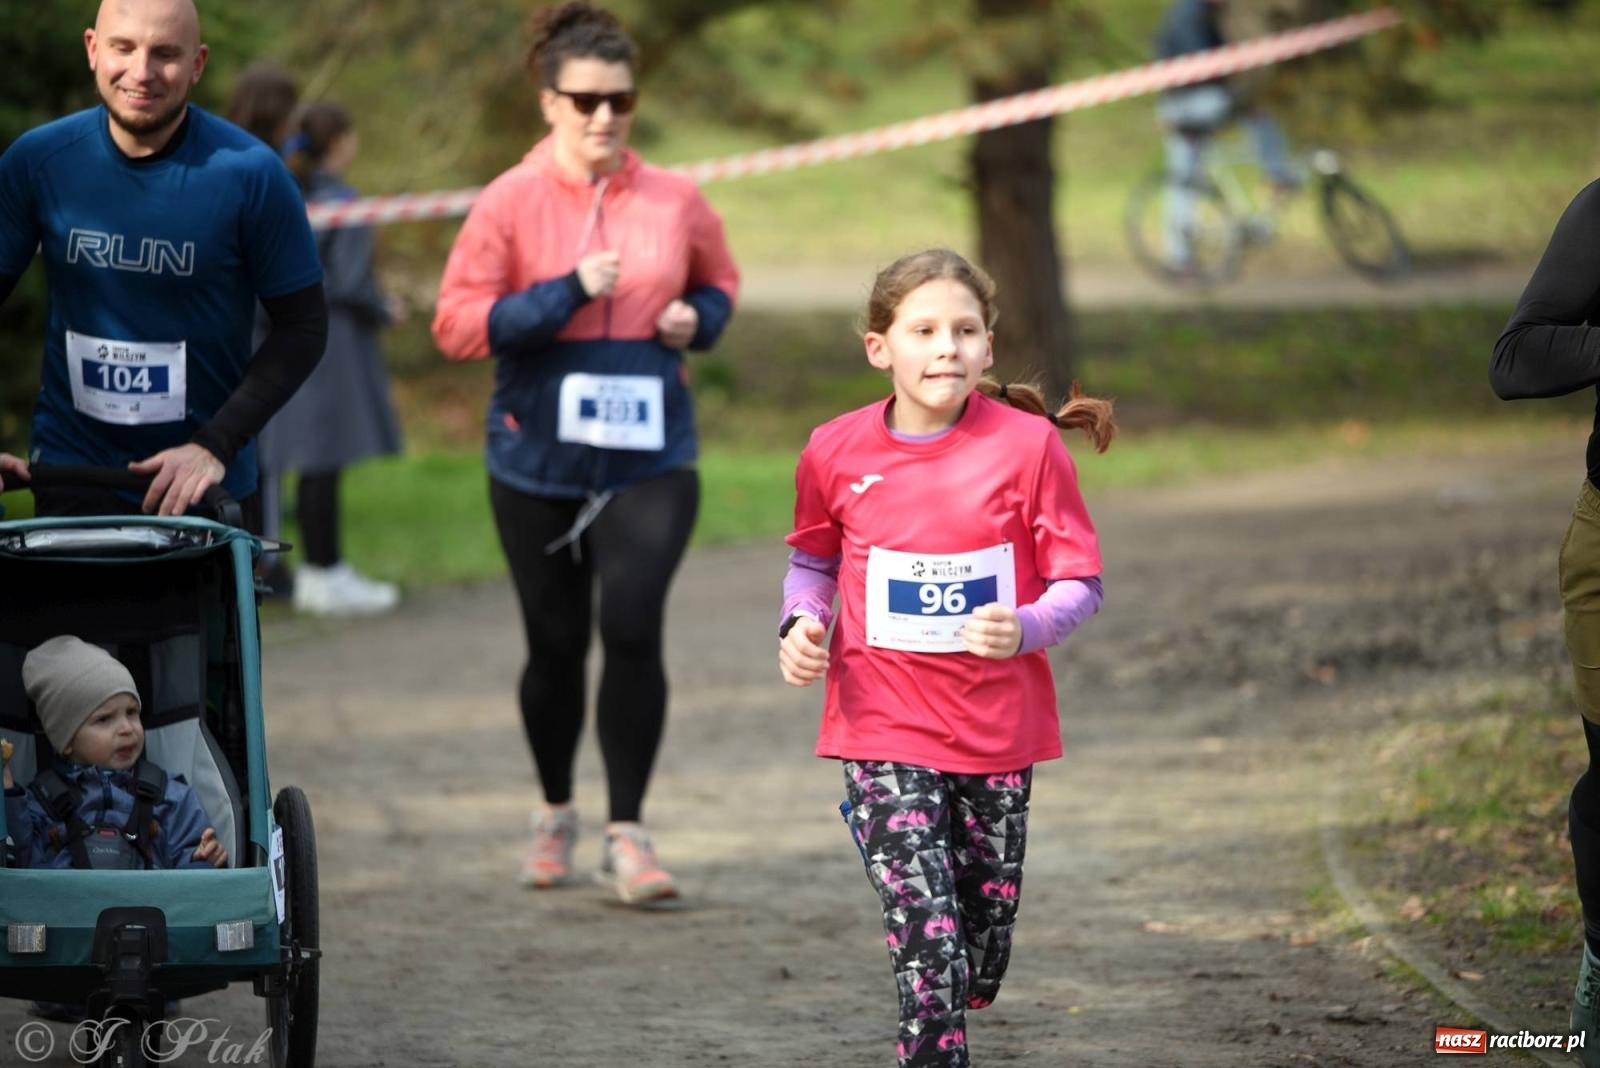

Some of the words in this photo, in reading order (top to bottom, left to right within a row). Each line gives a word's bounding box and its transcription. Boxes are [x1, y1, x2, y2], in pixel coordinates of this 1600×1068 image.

[66, 228, 195, 276] RUN
[97, 365, 152, 393] 104
[918, 582, 967, 615] 96
